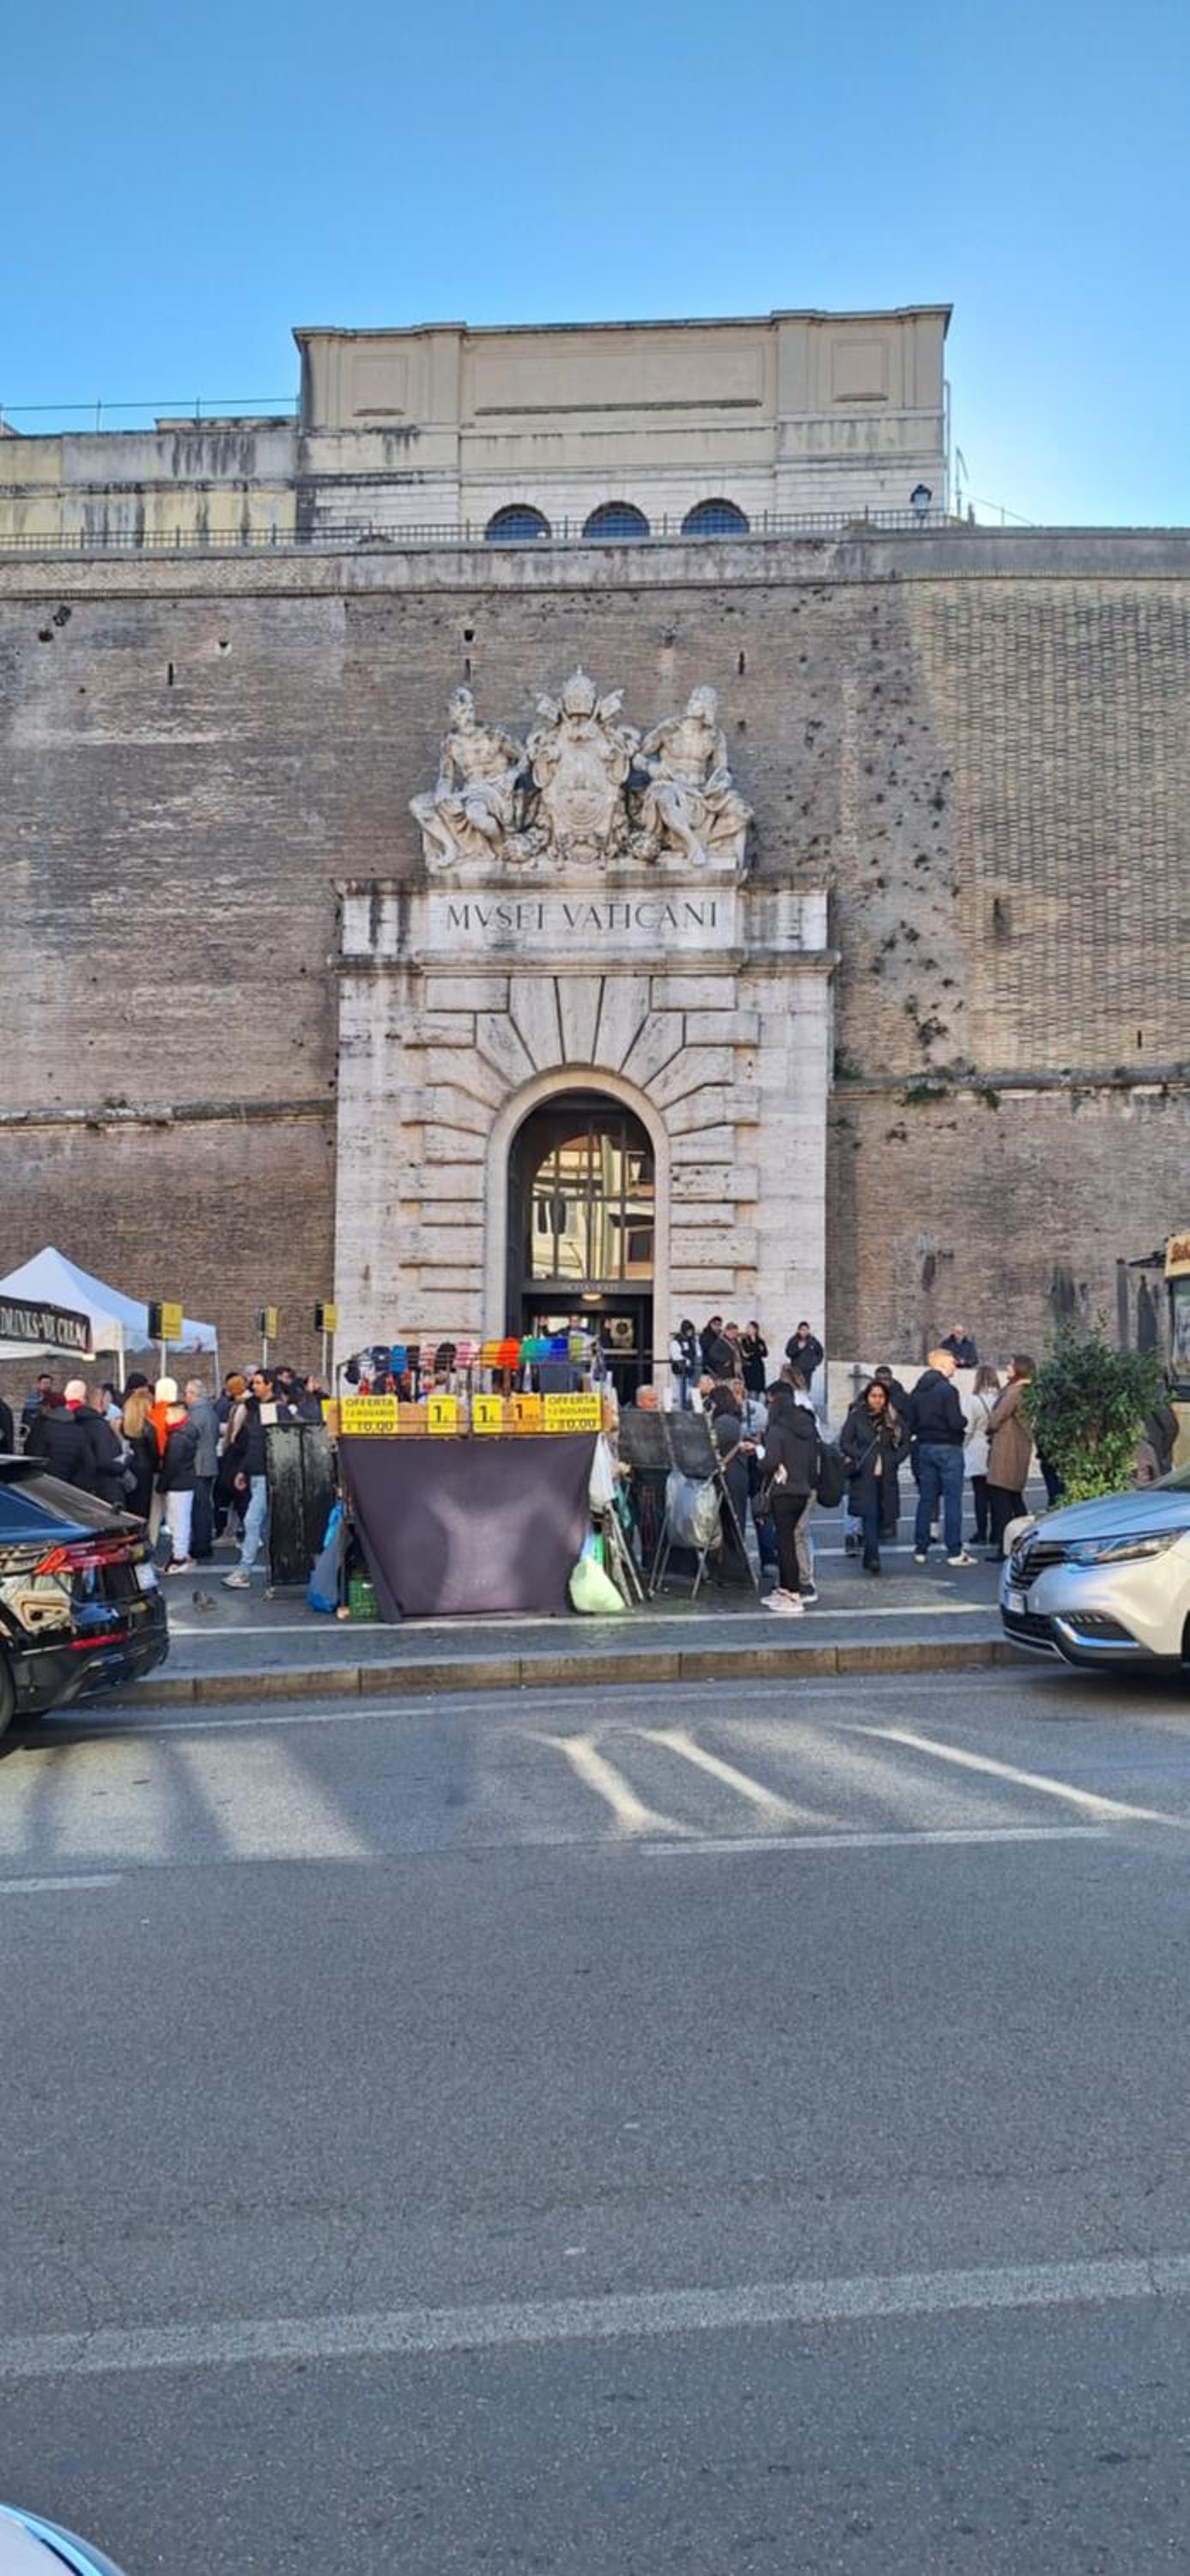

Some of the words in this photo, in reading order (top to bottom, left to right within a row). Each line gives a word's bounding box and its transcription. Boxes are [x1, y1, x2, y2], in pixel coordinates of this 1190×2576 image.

[446, 904, 544, 931] MVSEI
[562, 902, 717, 930] VATICANI
[345, 1398, 394, 1407] OFFERTA
[548, 1395, 596, 1406] OFFERTA
